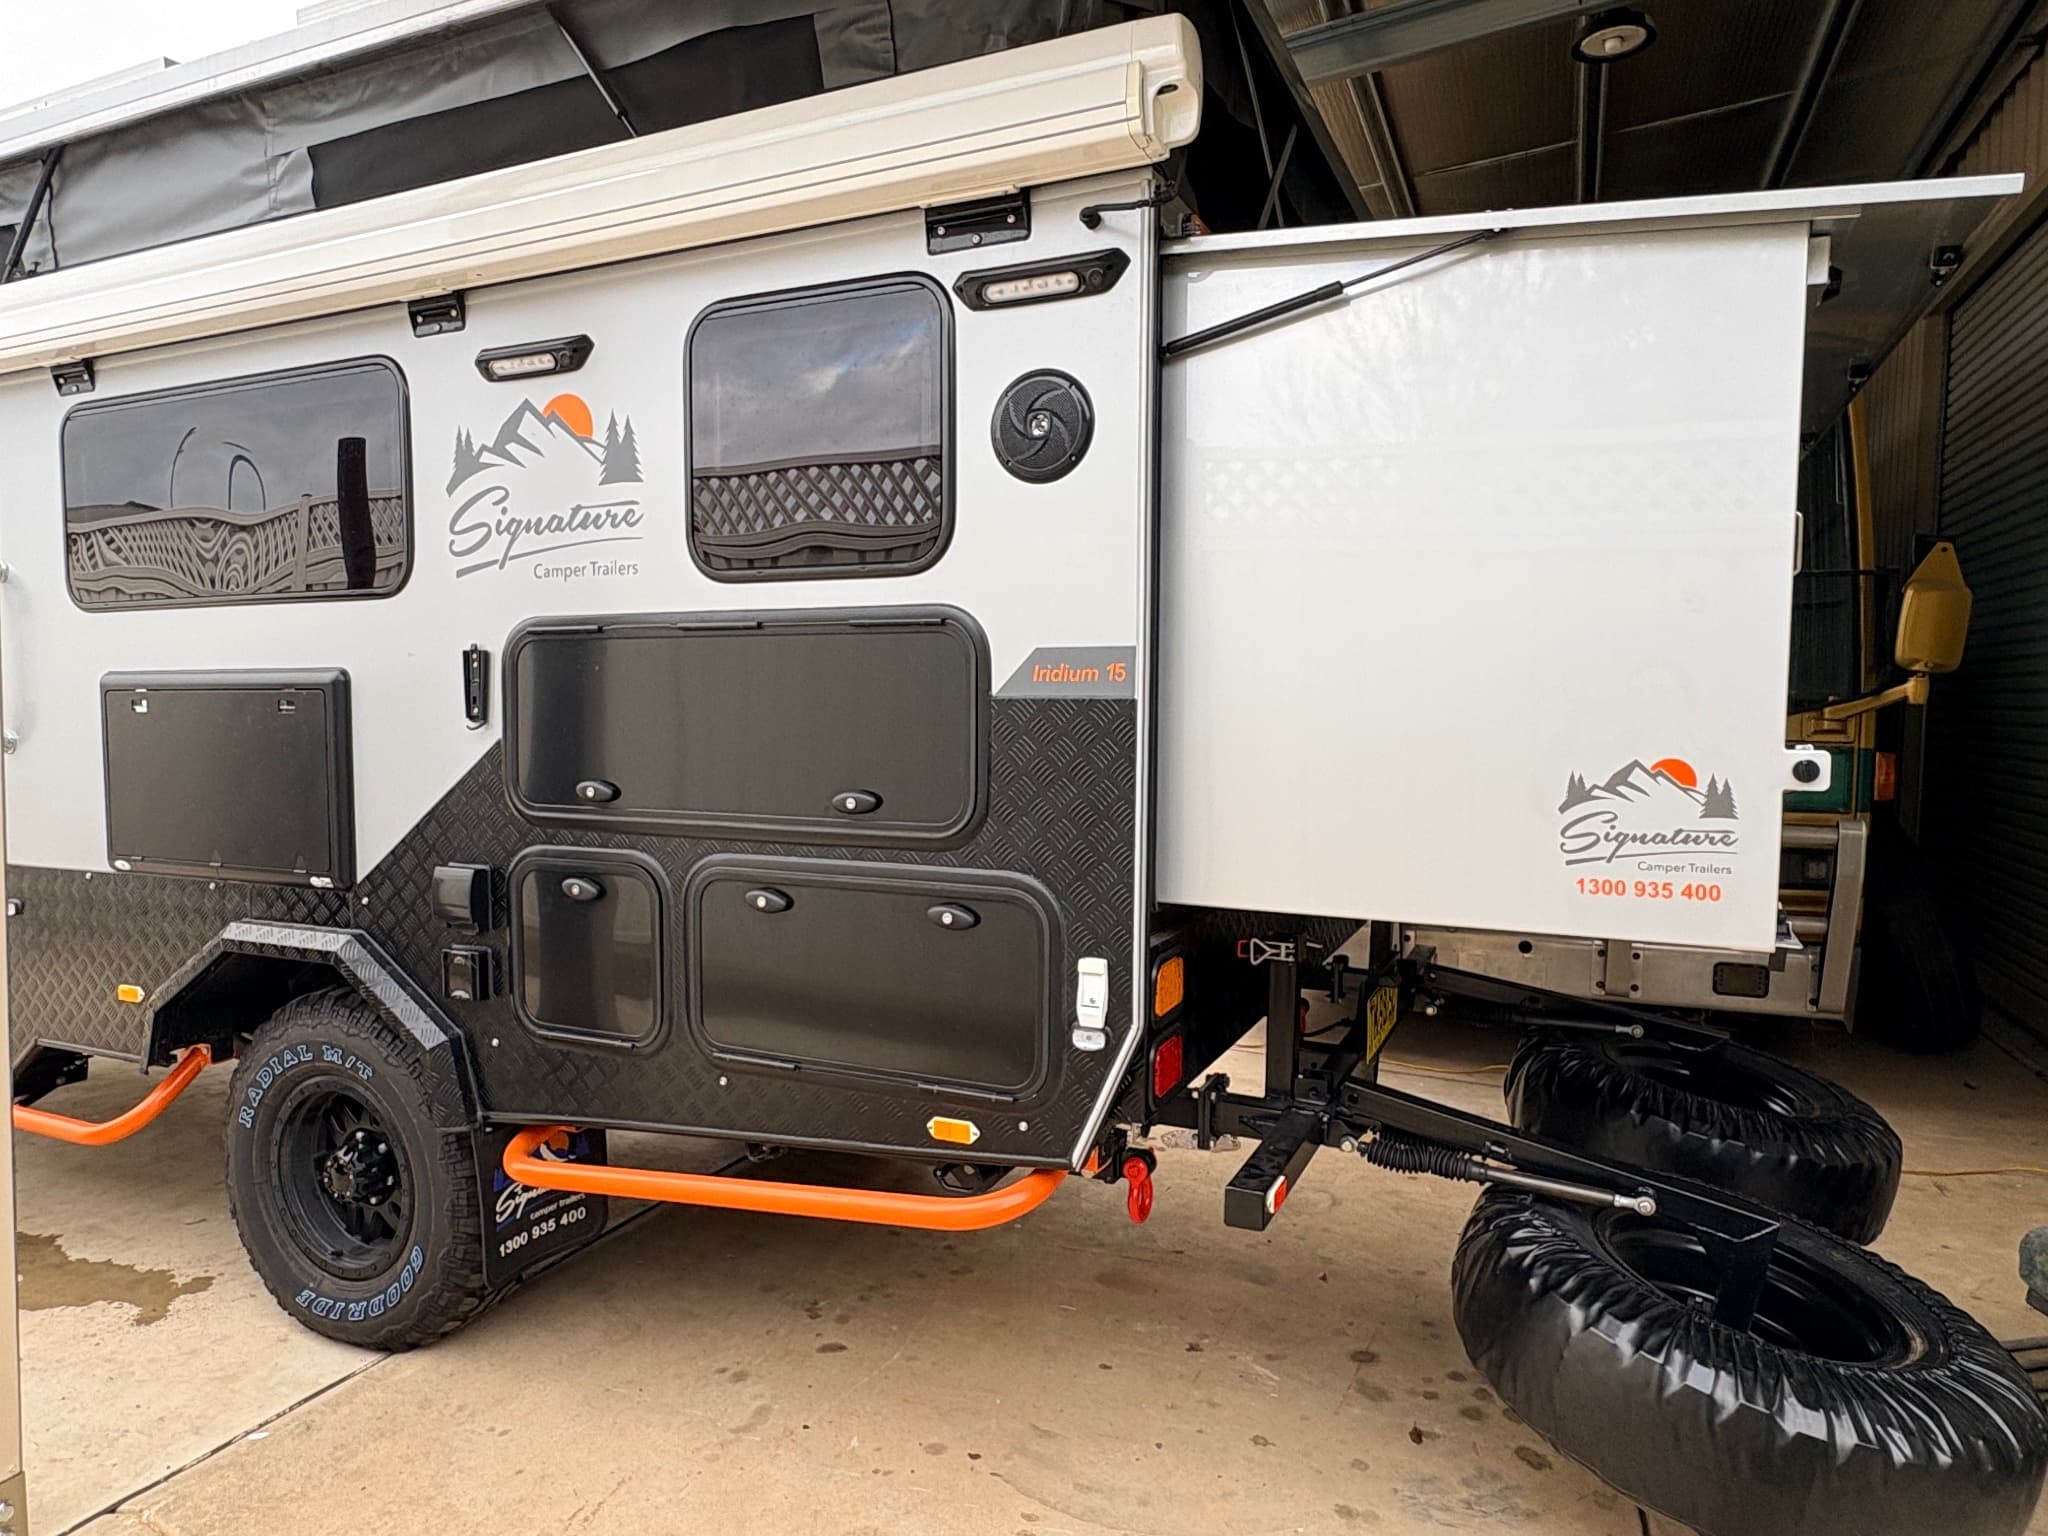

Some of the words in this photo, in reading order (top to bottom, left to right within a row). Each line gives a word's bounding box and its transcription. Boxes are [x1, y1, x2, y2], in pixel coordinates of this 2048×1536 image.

[449, 485, 645, 570] Signature
[533, 562, 587, 582] Camper
[589, 560, 639, 577] Trailers
[1032, 663, 1099, 683] Iridium
[1105, 661, 1127, 683] 15
[1560, 810, 1739, 864] Signature
[1576, 878, 1627, 897] 1300
[1634, 880, 1674, 900] 935
[1680, 883, 1722, 902] 400
[1637, 861, 1686, 875] Camper
[1688, 862, 1732, 875] Trailers
[238, 1044, 313, 1129] RADIAL
[499, 1231, 529, 1258] 1300
[531, 1217, 557, 1240] 935
[560, 1206, 587, 1226] 400
[295, 1245, 424, 1321] GOODRIDE
